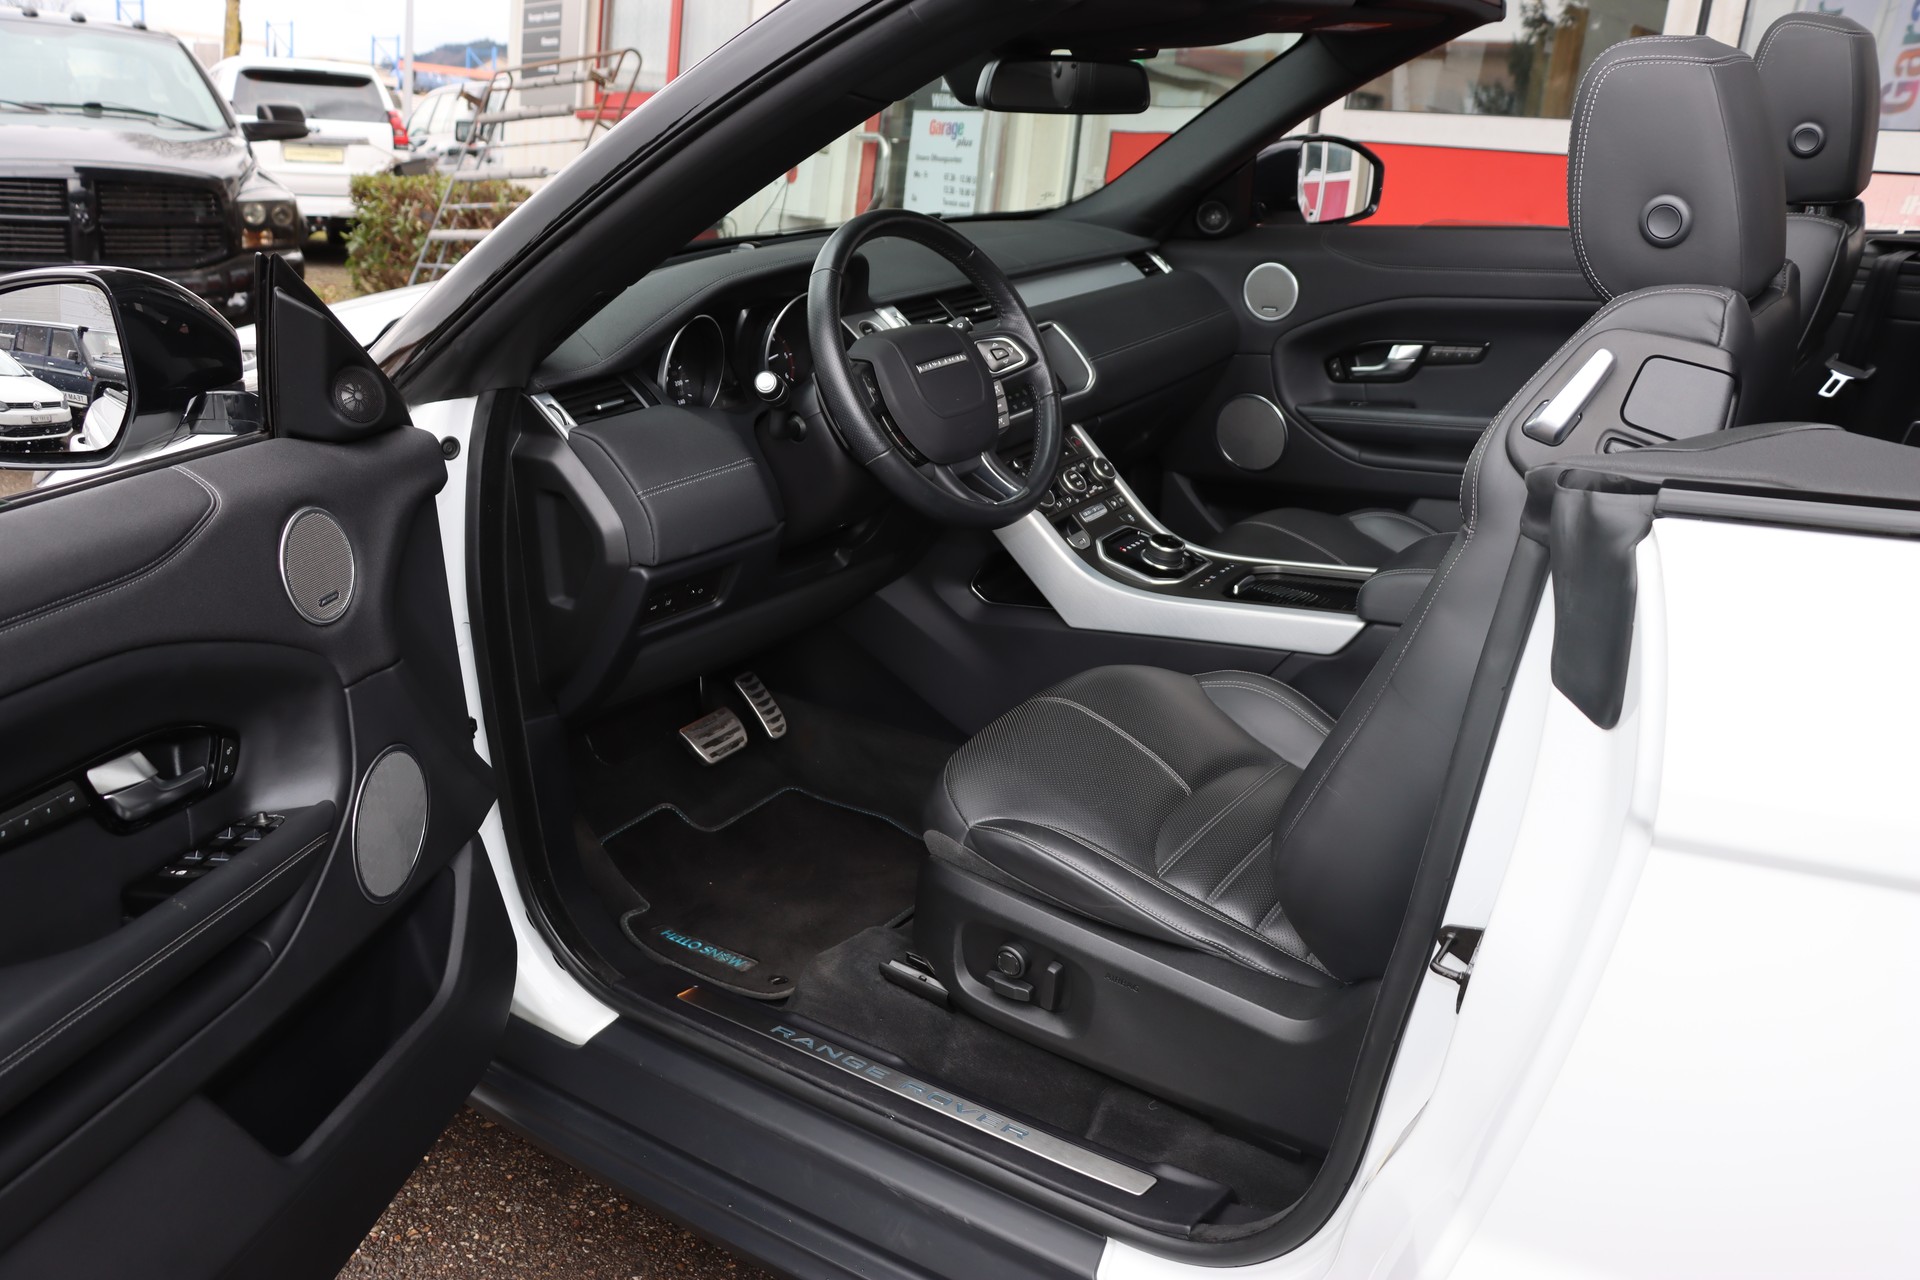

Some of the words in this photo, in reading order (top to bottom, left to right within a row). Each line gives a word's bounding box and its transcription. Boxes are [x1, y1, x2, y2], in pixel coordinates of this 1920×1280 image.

[929, 118, 965, 141] Garage
[660, 929, 702, 950] HELLO
[770, 1025, 892, 1080] RANGE
[900, 1080, 1030, 1141] ROVER
